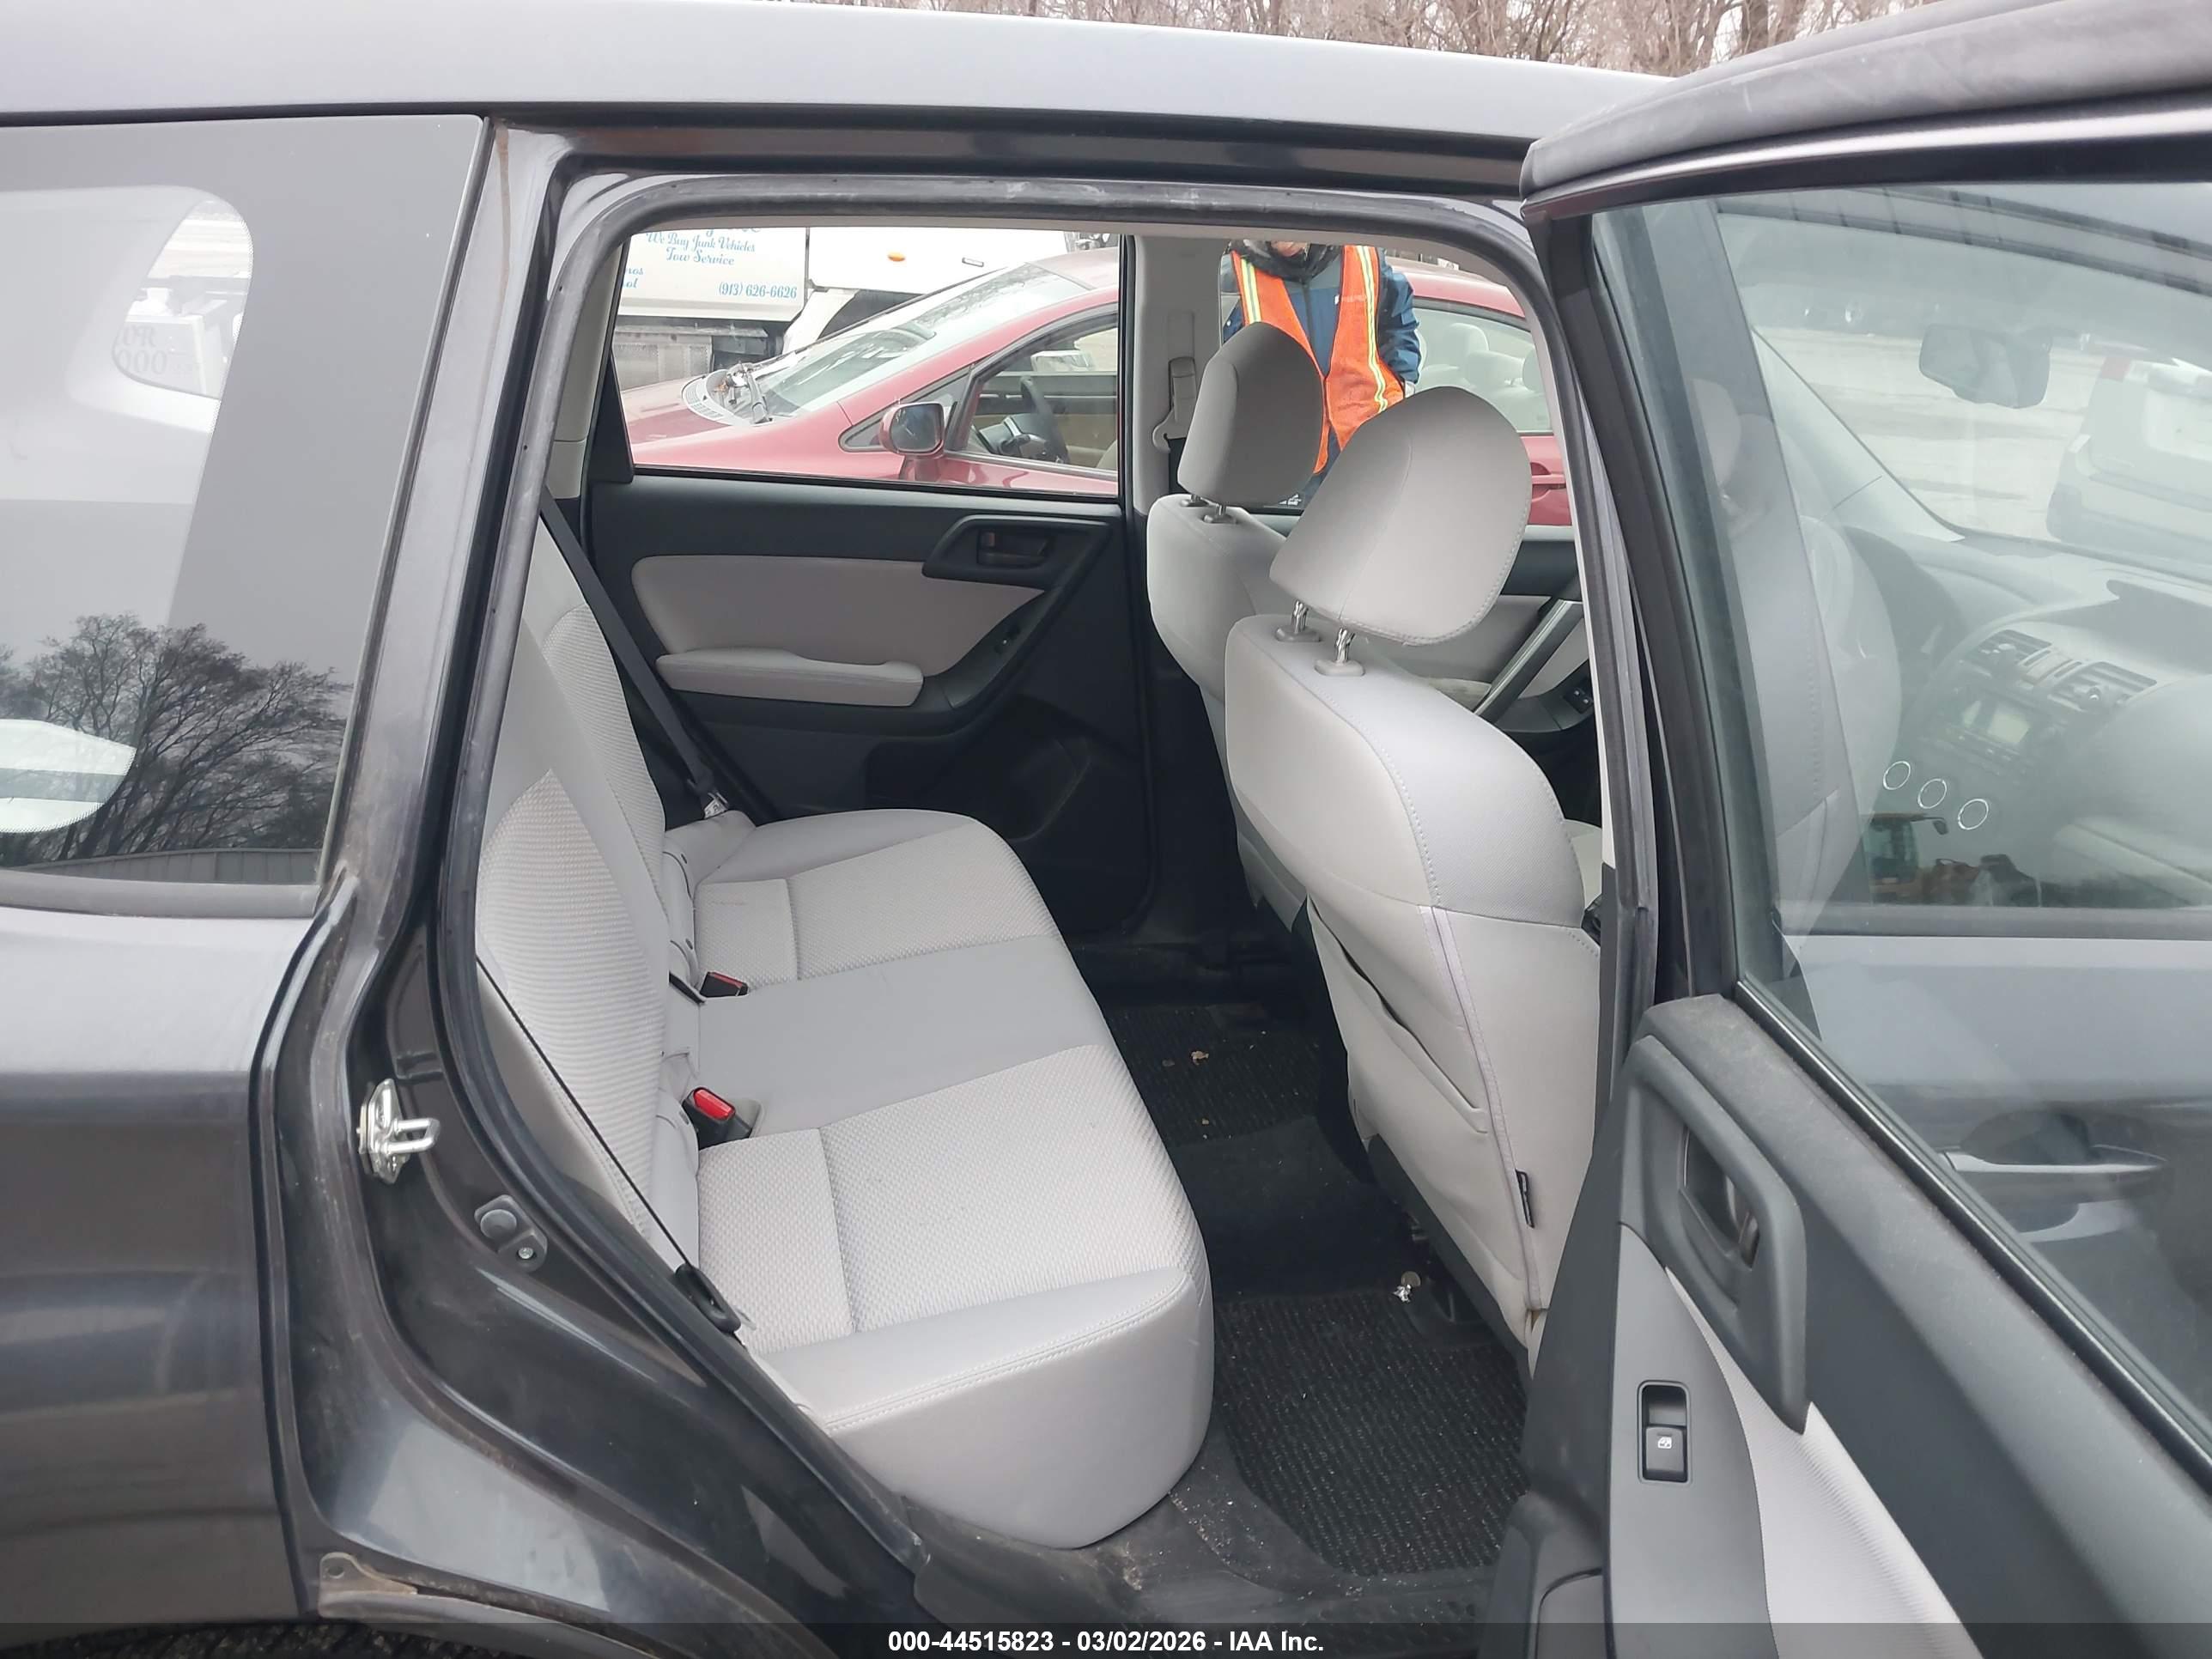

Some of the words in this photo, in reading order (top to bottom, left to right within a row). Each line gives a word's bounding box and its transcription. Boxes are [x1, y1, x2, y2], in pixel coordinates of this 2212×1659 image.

[646, 232, 665, 245] We
[668, 232, 689, 250] Buy
[692, 234, 715, 252] Junk
[718, 236, 756, 252] Vehicles
[666, 246, 690, 261] Tow
[693, 249, 735, 265] Service
[719, 282, 744, 296] (913)
[745, 283, 798, 299] 626-6626
